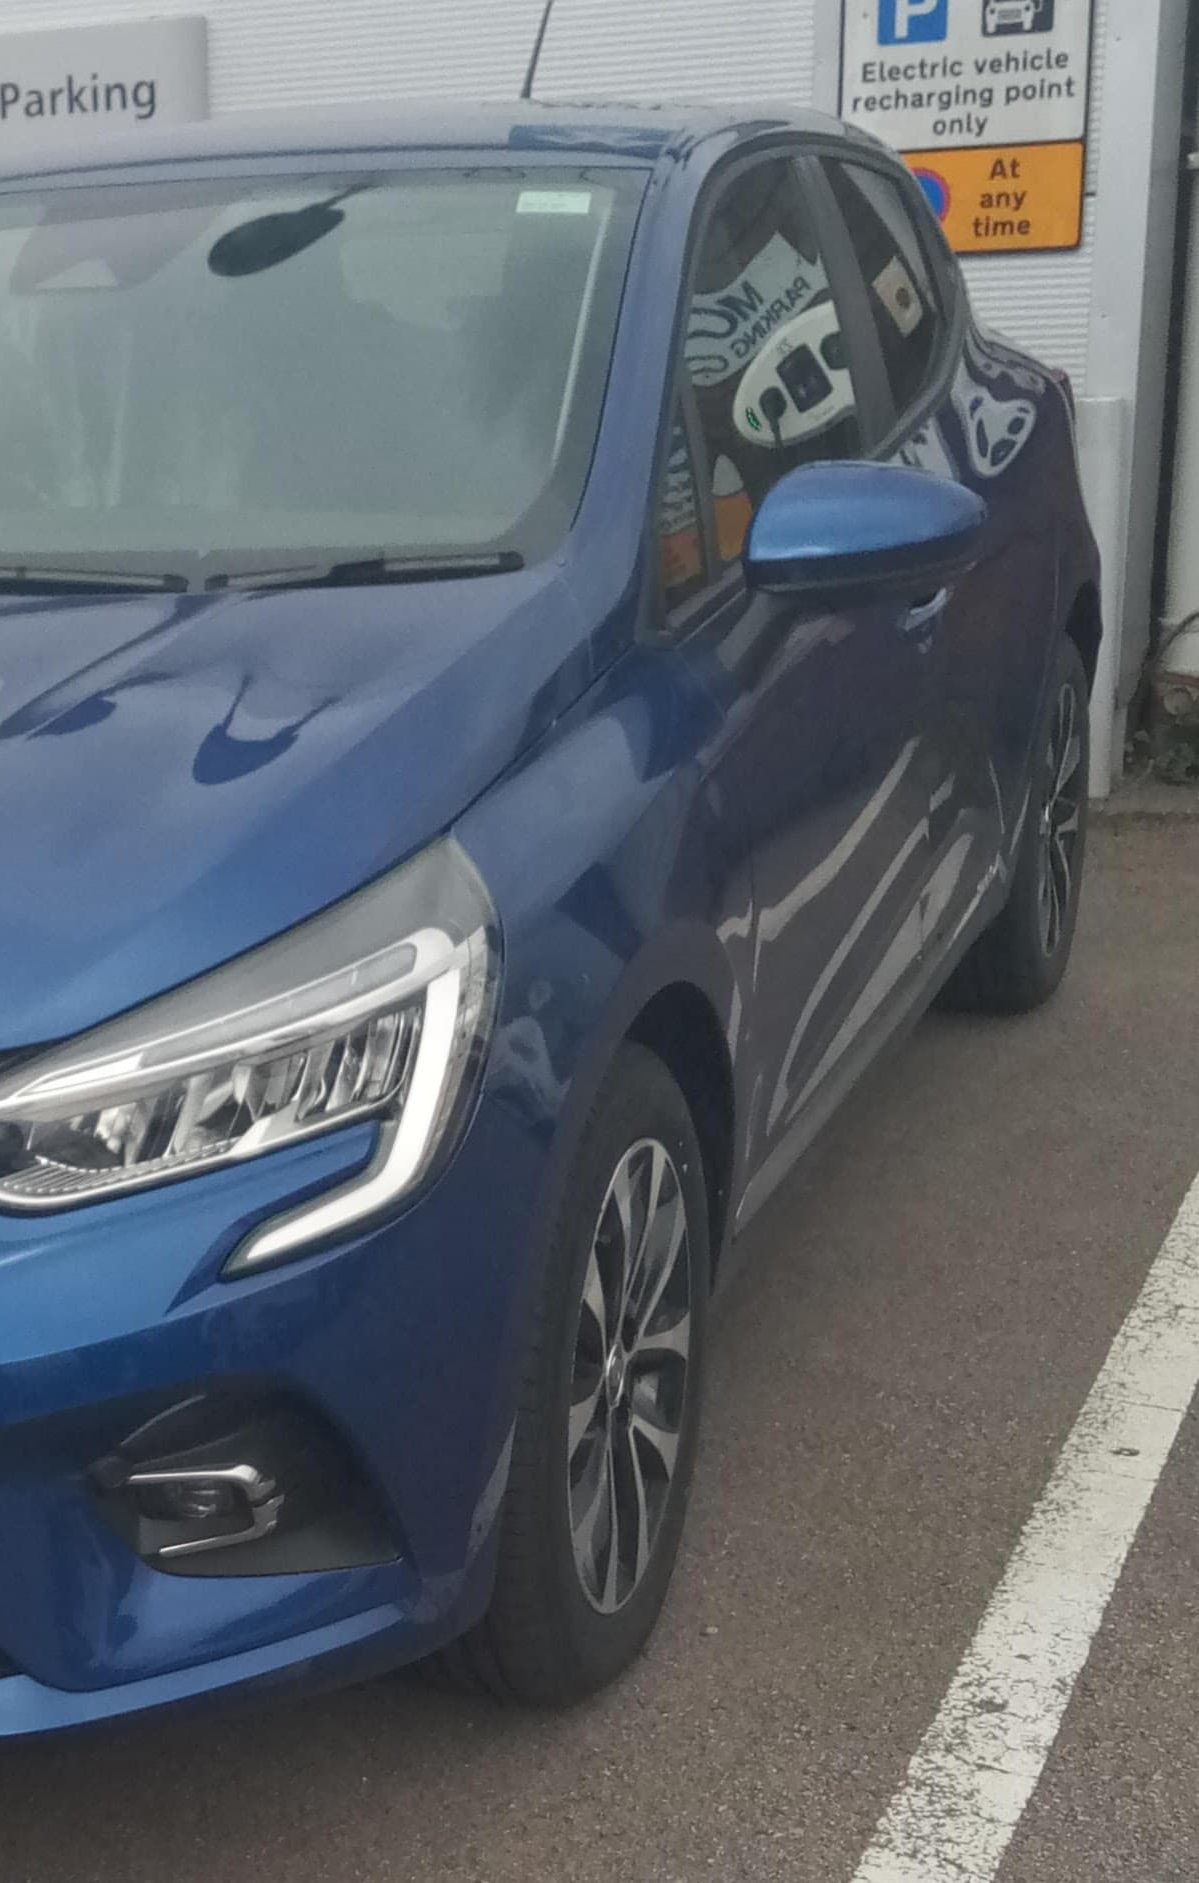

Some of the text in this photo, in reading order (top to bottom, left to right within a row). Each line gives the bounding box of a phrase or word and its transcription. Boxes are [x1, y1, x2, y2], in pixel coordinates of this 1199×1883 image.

[861, 48, 1069, 83] Electric vehicle
[0, 73, 158, 121] Parking
[852, 77, 1075, 112] recharging point
[932, 113, 989, 137] only
[989, 158, 1020, 180] At
[980, 190, 1027, 211] any
[972, 217, 1031, 237] time
